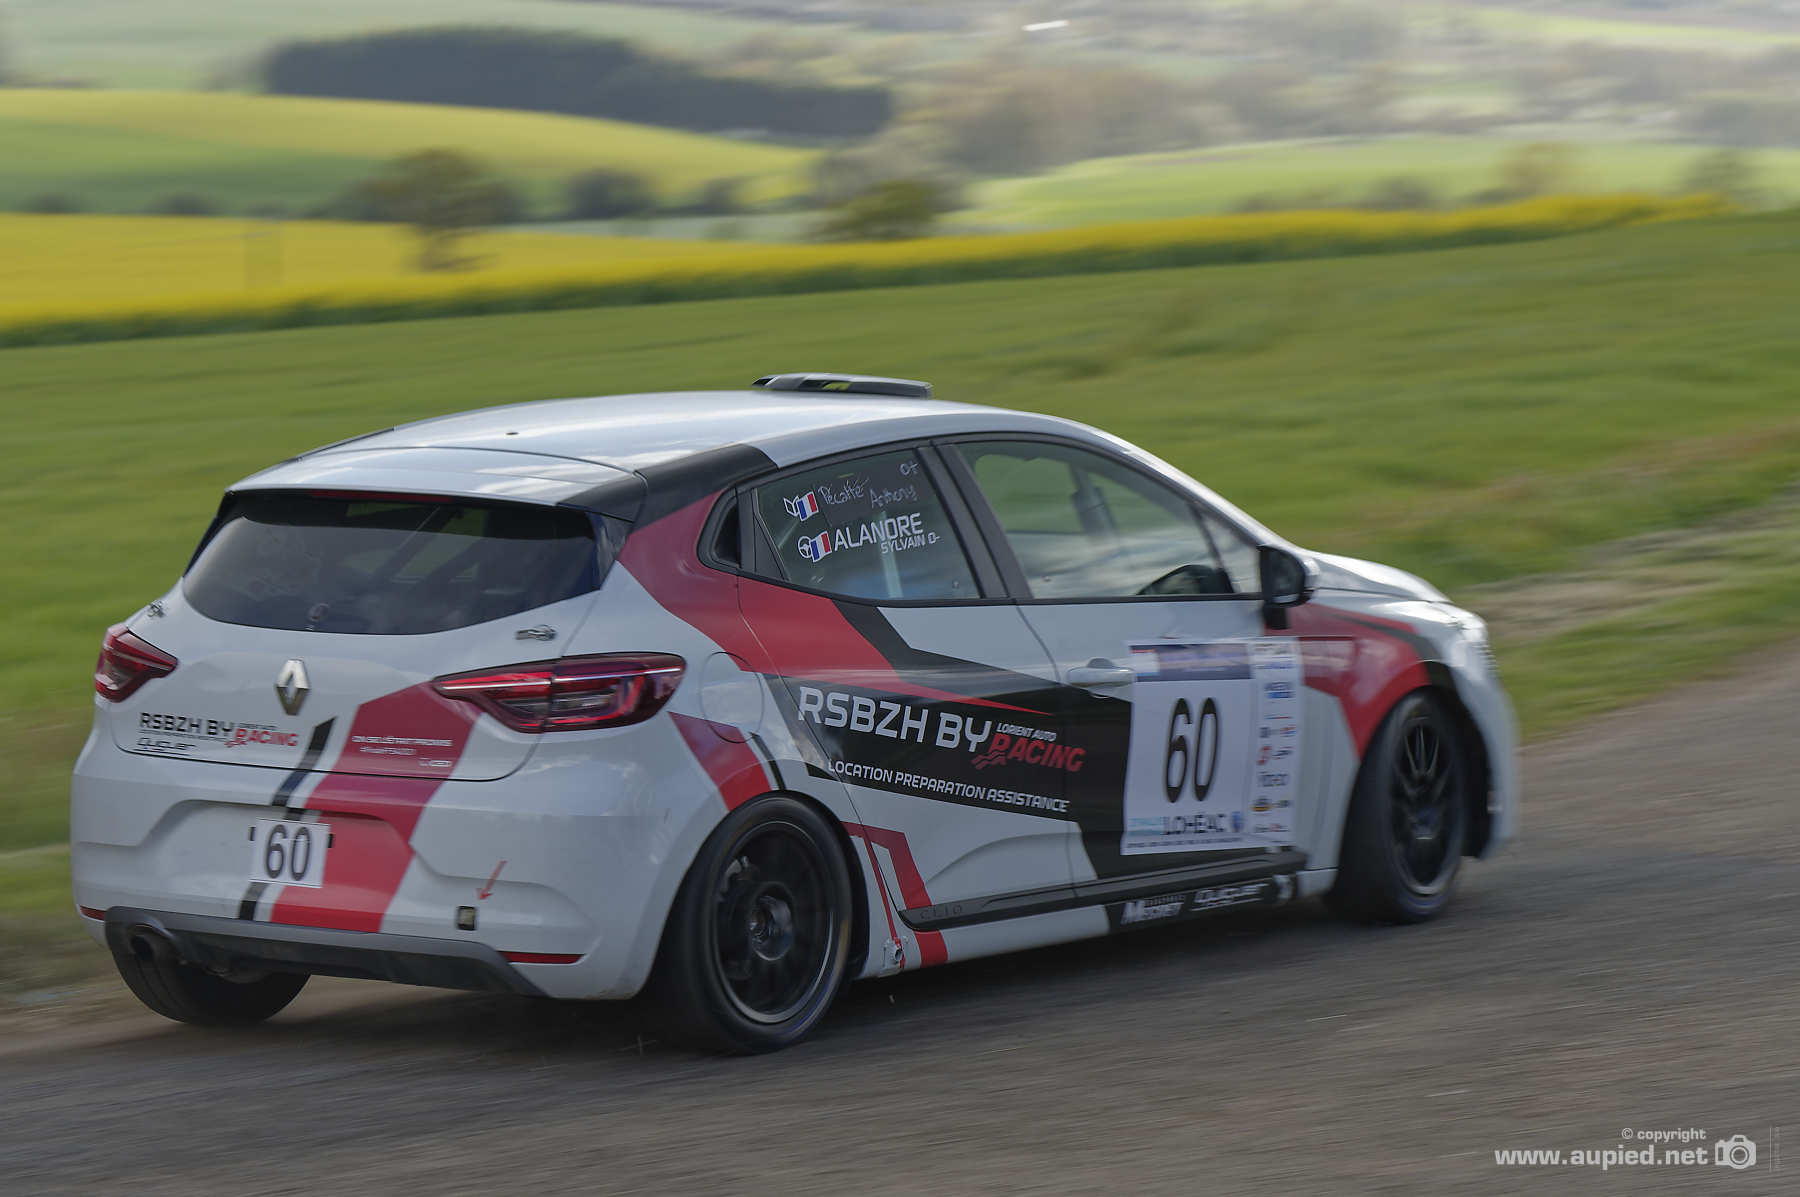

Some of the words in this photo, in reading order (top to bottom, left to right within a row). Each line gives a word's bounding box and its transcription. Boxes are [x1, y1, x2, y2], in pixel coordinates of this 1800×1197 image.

[881, 535, 925, 554] SYLVAIN
[139, 712, 200, 733] RSBZH
[207, 719, 234, 737] BY
[797, 686, 929, 743] RSBZH
[935, 712, 993, 753] BY
[985, 733, 1086, 772] RACING
[1165, 697, 1219, 803] 60
[828, 759, 894, 783] LOCATION
[895, 771, 986, 800] PREPARATION
[986, 788, 1070, 813] ASSISTANCE
[265, 824, 311, 881] 60
